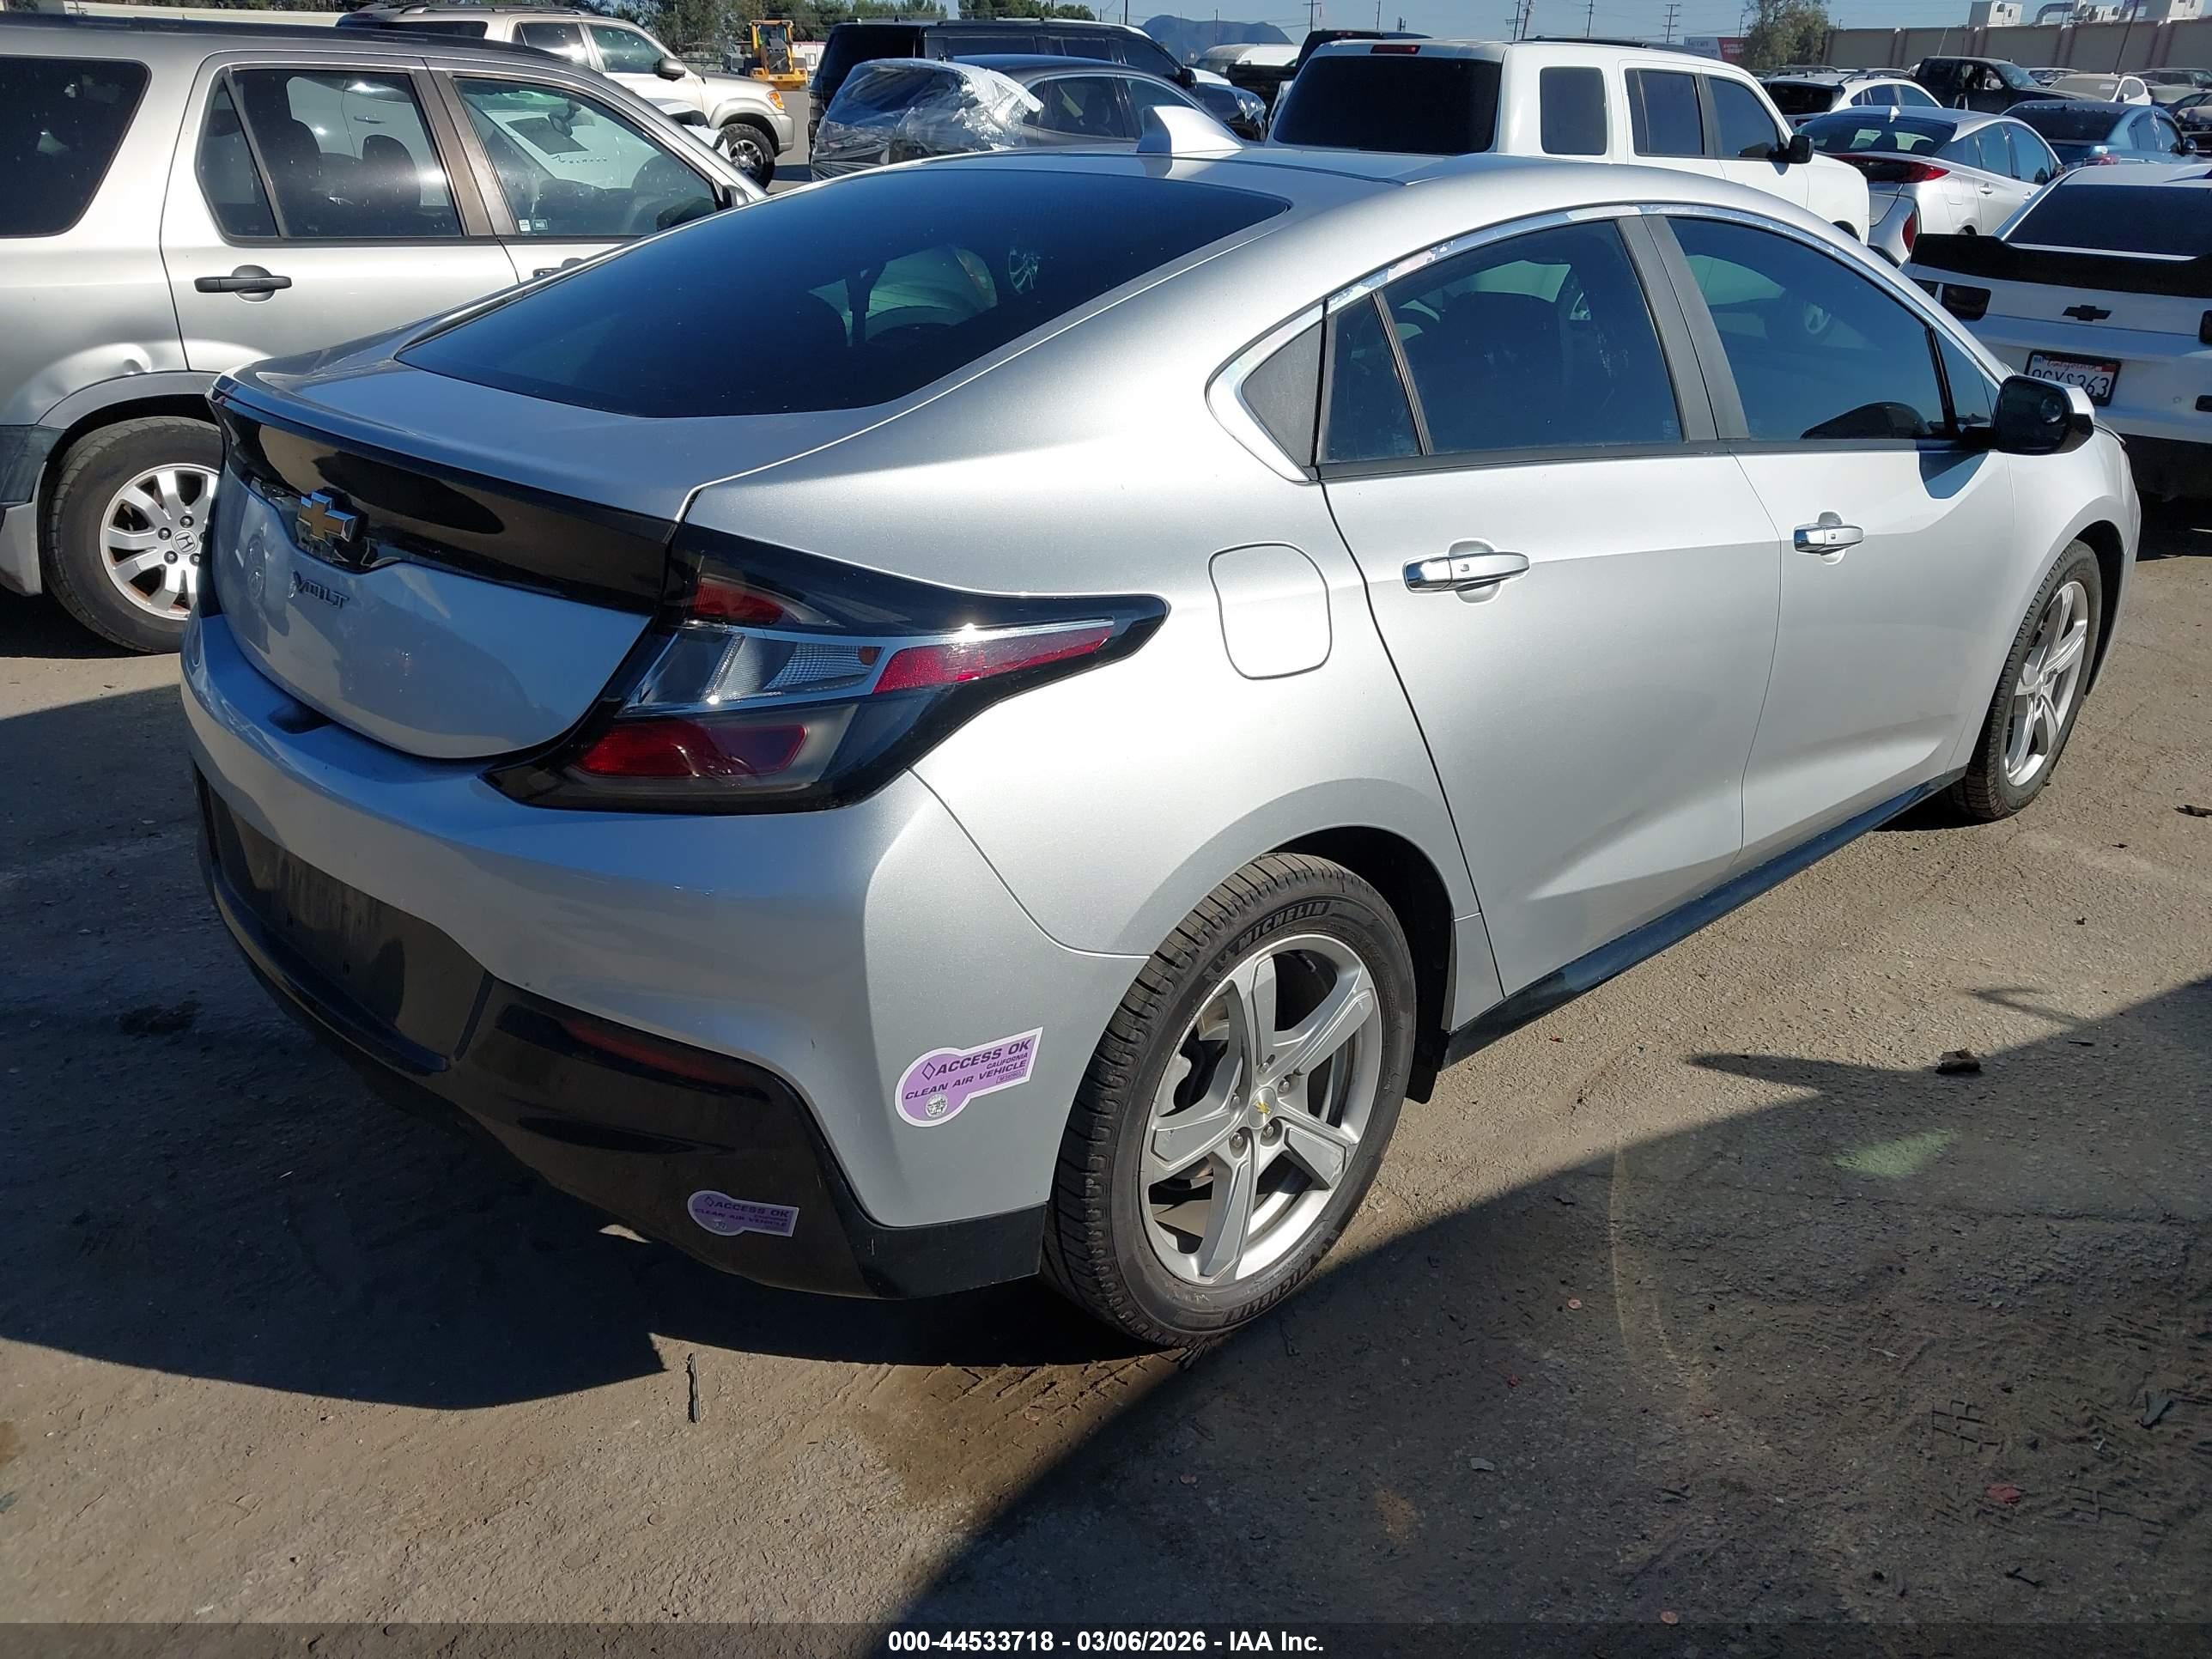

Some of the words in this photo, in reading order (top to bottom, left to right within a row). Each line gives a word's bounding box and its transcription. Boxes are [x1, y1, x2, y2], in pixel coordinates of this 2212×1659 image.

[289, 570, 349, 610] VOLT
[1237, 901, 1329, 951] MICHELIN
[935, 1048, 1003, 1076] ACCESS
[1007, 1039, 1032, 1055] OK
[986, 1053, 1028, 1070] CALIFORNIA
[905, 1084, 948, 1100] CLEAN
[952, 1076, 975, 1088] AIR
[979, 1060, 1027, 1080] VEHICLE
[694, 1208, 726, 1218] CLEAN
[714, 1201, 765, 1215] ACCESS
[770, 1209, 791, 1218] OK
